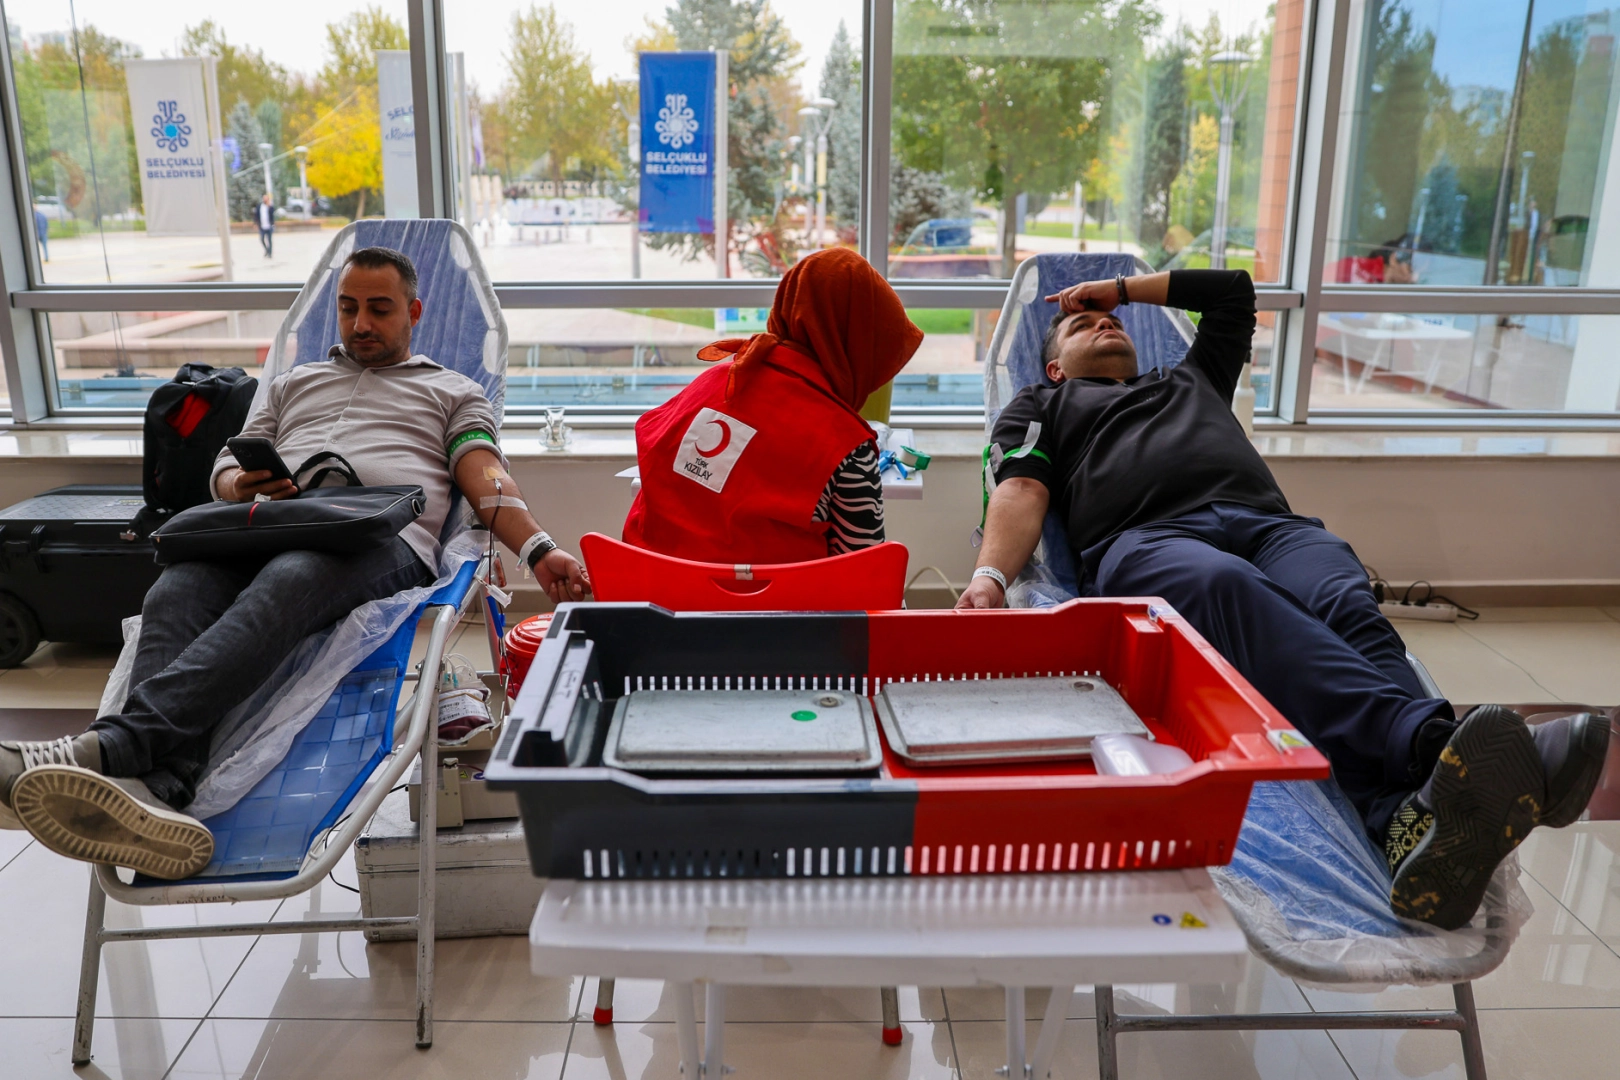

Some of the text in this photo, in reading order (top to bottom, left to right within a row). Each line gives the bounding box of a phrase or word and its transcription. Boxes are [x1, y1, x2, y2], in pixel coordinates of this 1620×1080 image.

[146, 157, 204, 168] SELÇUKLU
[646, 151, 707, 164] SELÇUKLU
[695, 457, 709, 469] TÜRK
[684, 461, 713, 481] KIZILAY
[1389, 812, 1434, 877] didas
